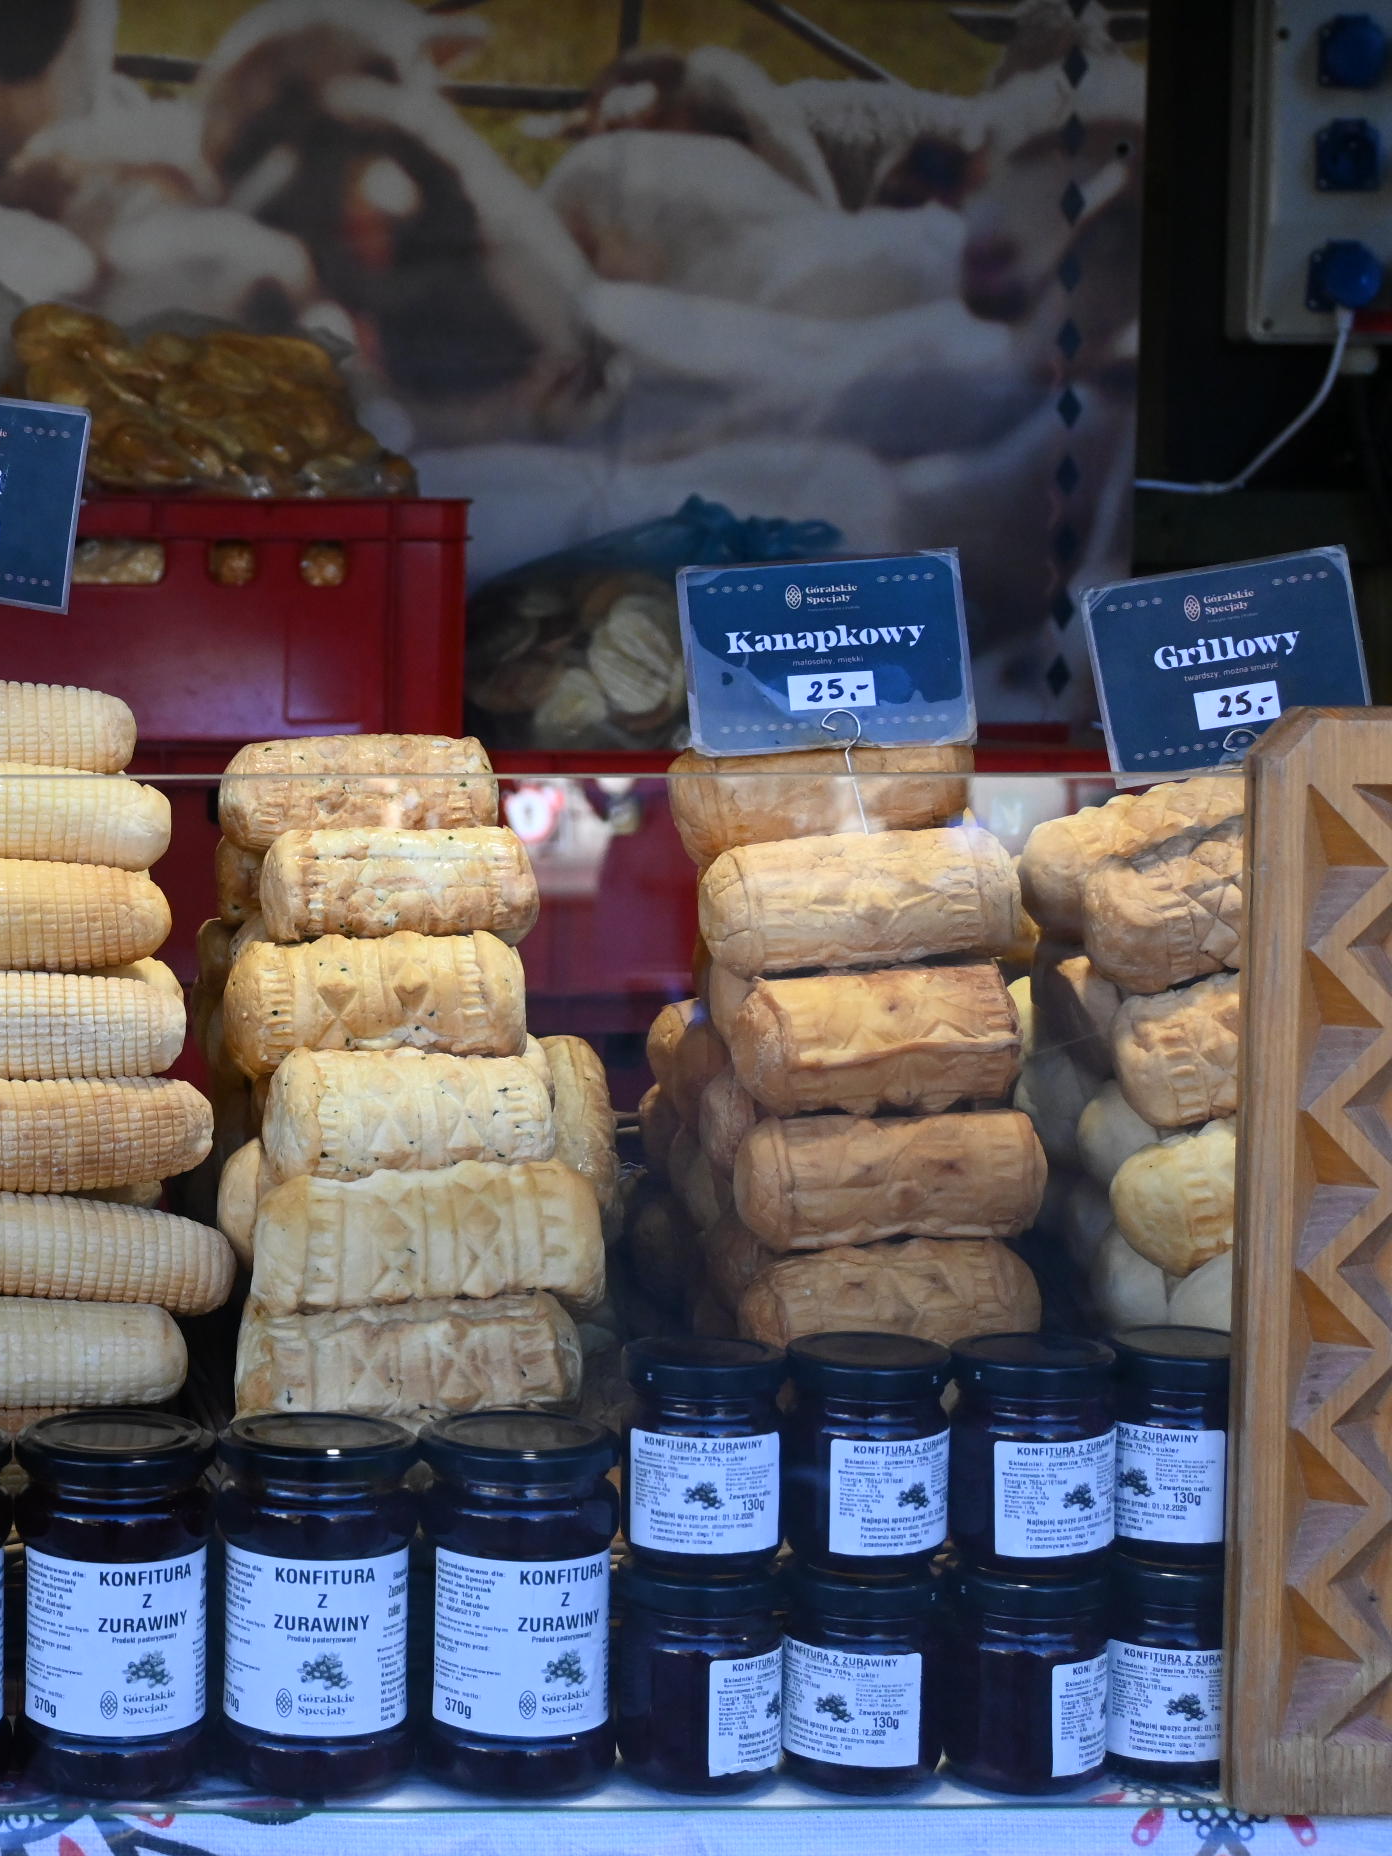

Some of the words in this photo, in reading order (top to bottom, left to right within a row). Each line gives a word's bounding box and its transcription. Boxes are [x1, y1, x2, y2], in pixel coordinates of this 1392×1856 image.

[806, 583, 858, 594] Góralskie
[1203, 588, 1254, 604] Góralskie
[725, 624, 925, 654] Kanapkowy
[1154, 631, 1300, 670] Grillowy
[854, 1445, 912, 1454] KONFITURA
[1017, 1446, 1075, 1456] KONFITURA
[743, 1499, 765, 1511] 130g
[1174, 1492, 1201, 1505] 130g
[99, 1563, 191, 1587] KONFITURA
[275, 1567, 375, 1585] KONFITURA
[520, 1561, 603, 1586] KONFITURA
[143, 1594, 152, 1608] Z
[318, 1594, 327, 1608] Z
[561, 1592, 570, 1607] Z
[1124, 1648, 1181, 1663] KONFITURA
[123, 1690, 176, 1703] Góralskie
[298, 1694, 355, 1703] Góralskie
[542, 1689, 590, 1702] Góralskie
[34, 1695, 56, 1718] 370g
[445, 1697, 471, 1719] 370g
[873, 1717, 899, 1730] 130g
